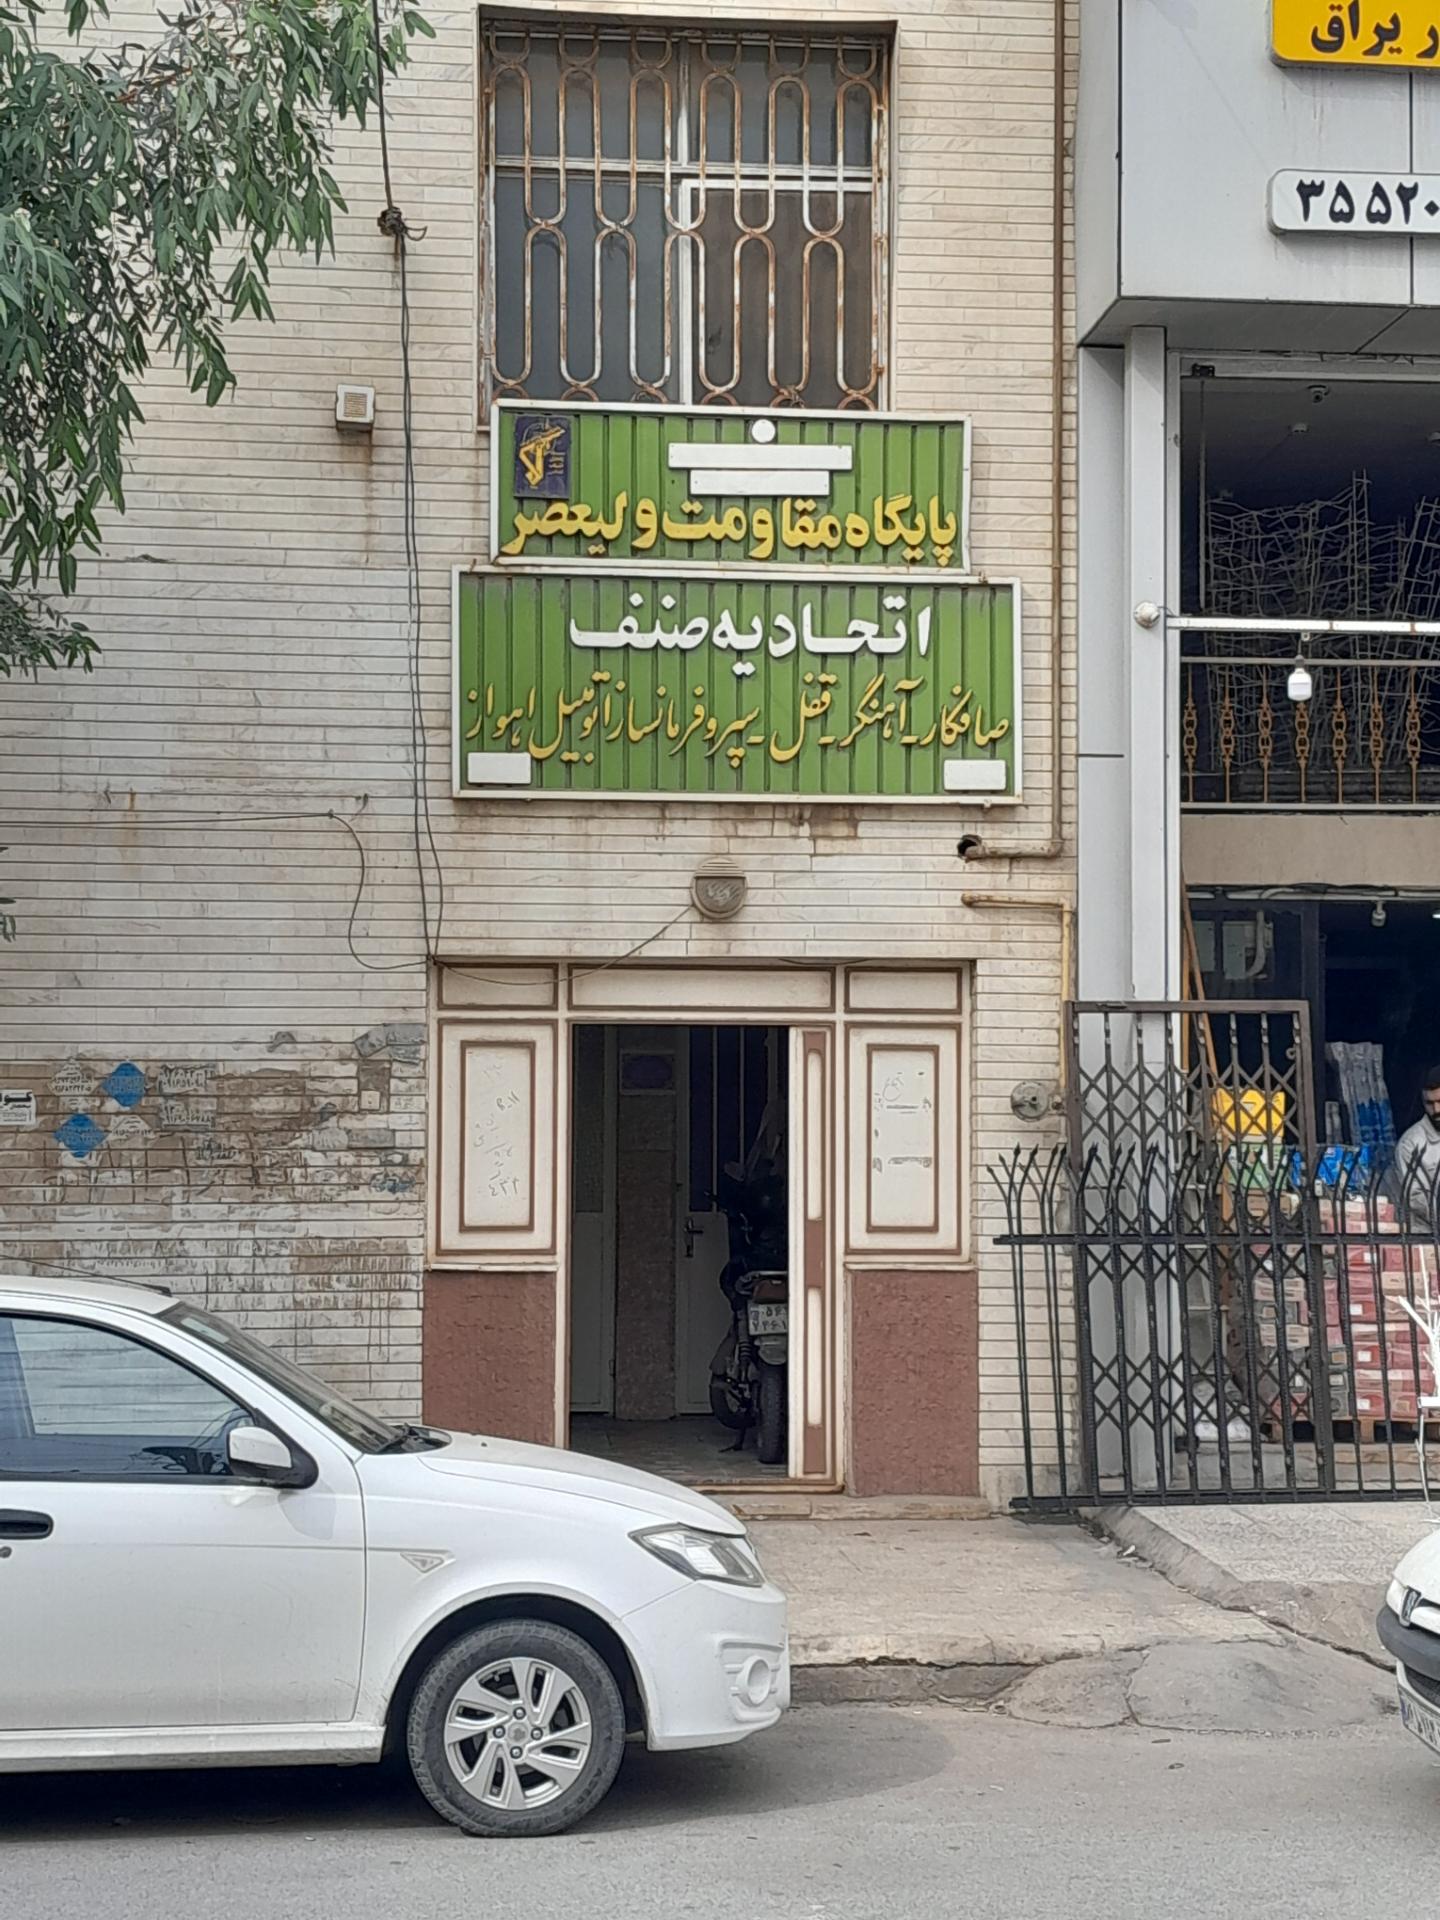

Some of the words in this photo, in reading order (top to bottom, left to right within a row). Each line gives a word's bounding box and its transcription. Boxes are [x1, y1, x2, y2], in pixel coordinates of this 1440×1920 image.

[1311, 0, 1403, 57] یراق
[662, 497, 842, 559] مقاومت
[844, 493, 957, 567] پایگاه
[569, 592, 710, 650] صنف
[711, 595, 931, 676] اتحادیه
[465, 682, 536, 747] اهواز
[527, 670, 613, 763] اتومبیل
[769, 671, 838, 763] قفل
[838, 672, 925, 748] آهنگر
[919, 684, 1010, 747] صافکار
